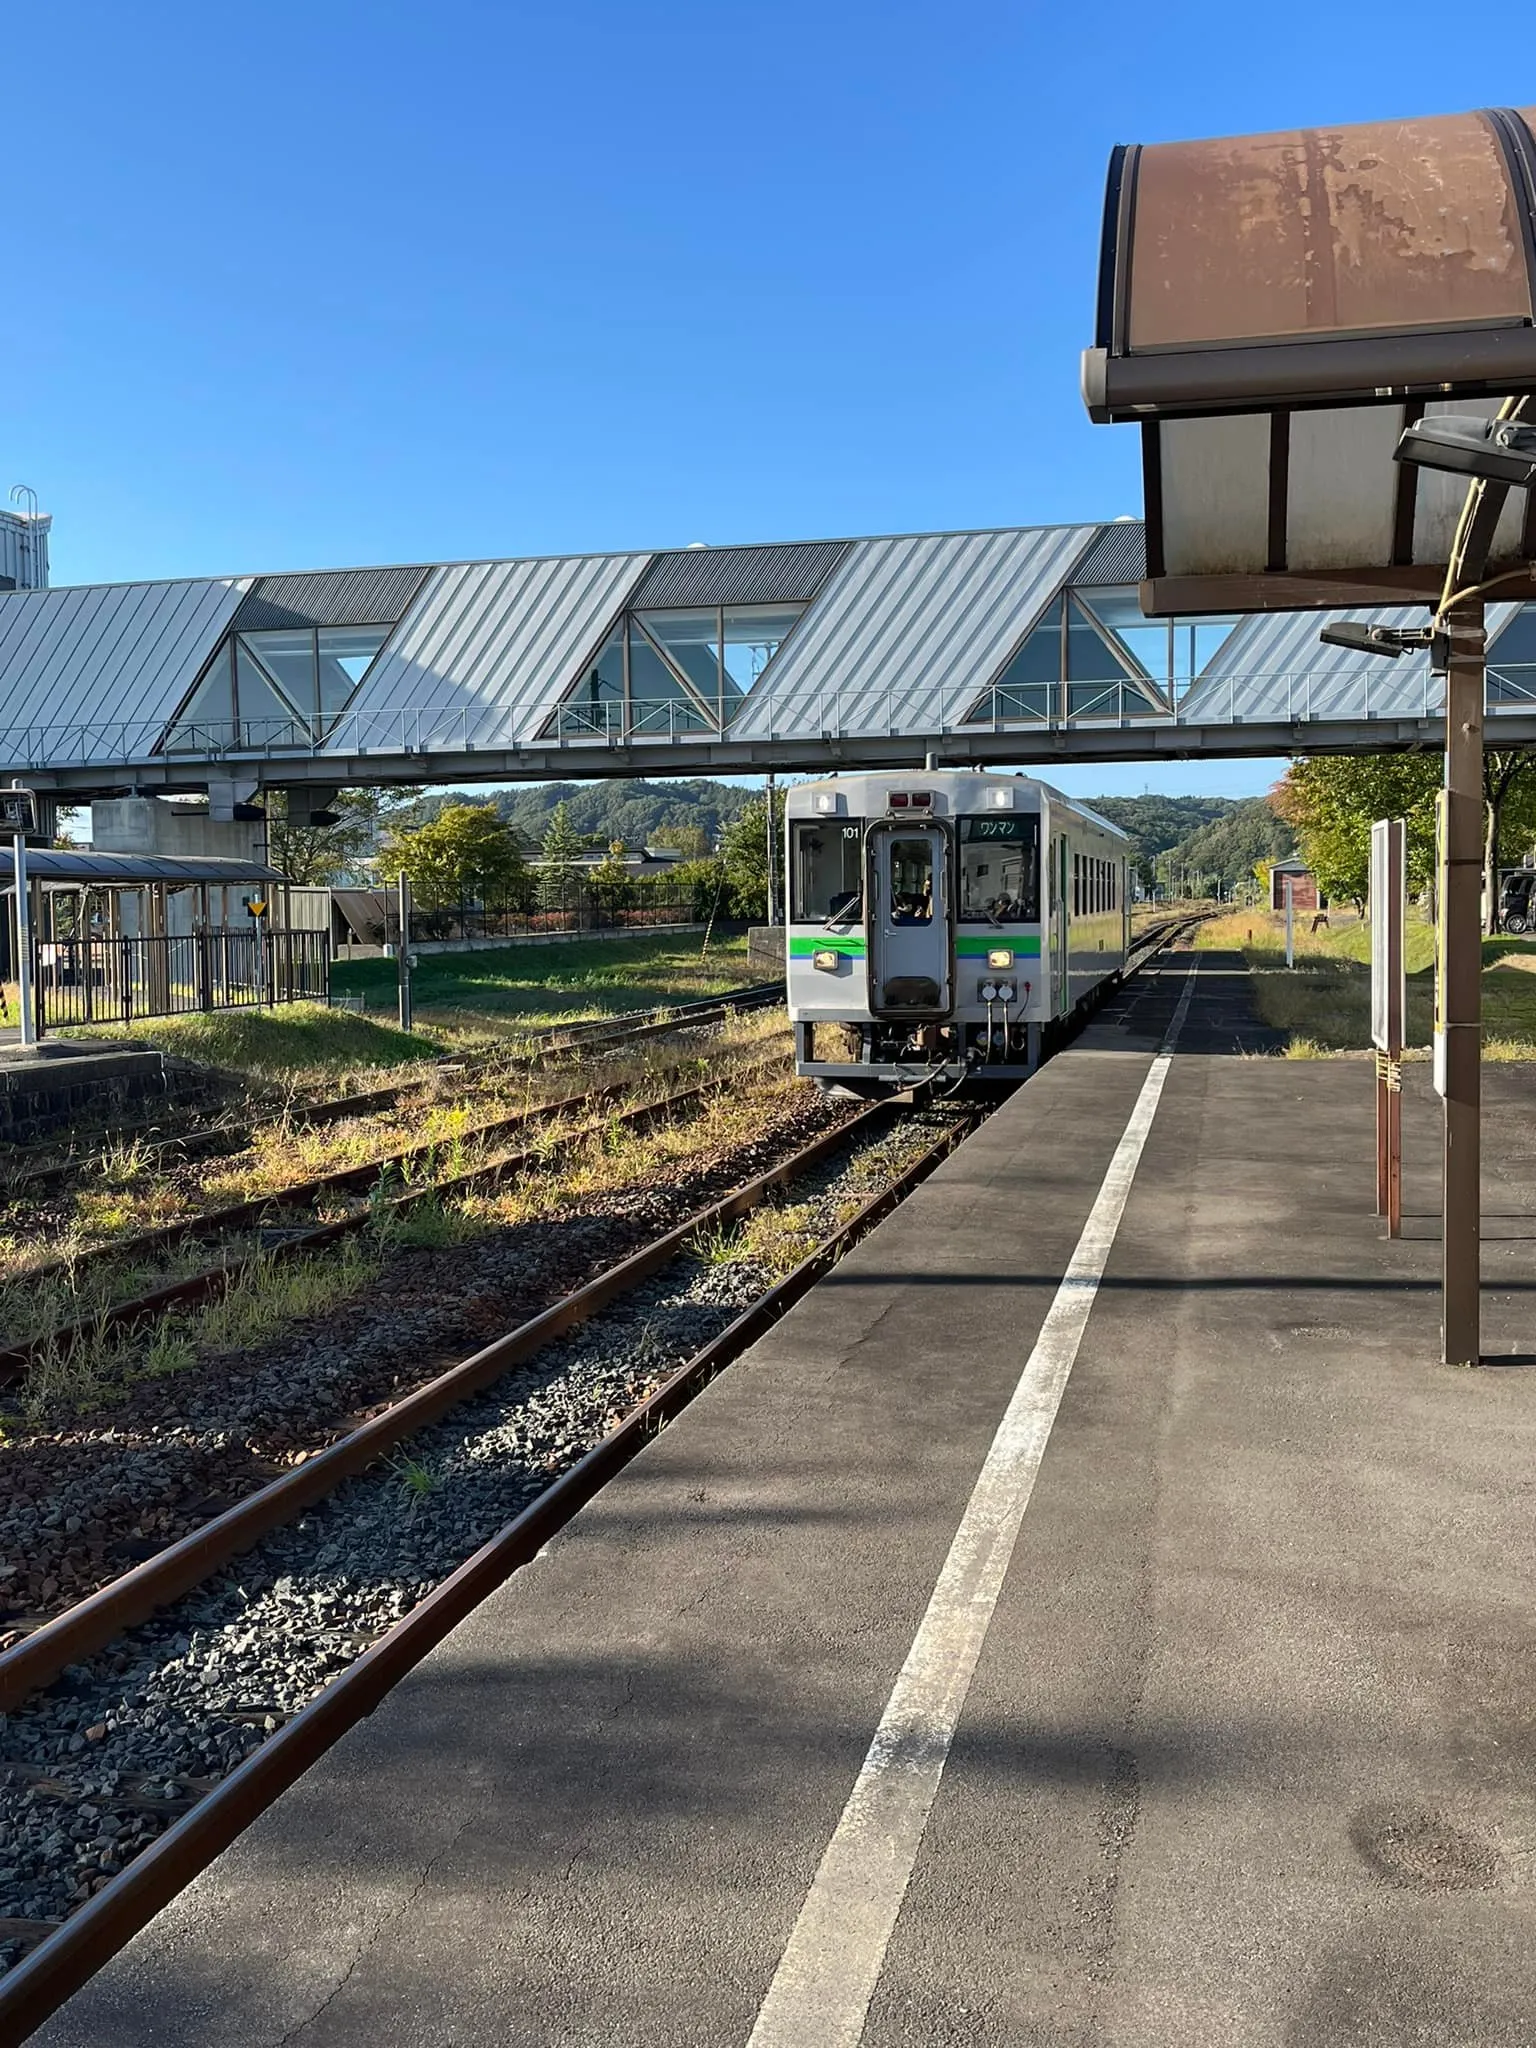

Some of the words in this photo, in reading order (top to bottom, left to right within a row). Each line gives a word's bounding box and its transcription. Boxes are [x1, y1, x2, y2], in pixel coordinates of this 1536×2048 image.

[842, 827, 859, 839] 101
[980, 821, 1015, 835] ワンマン
